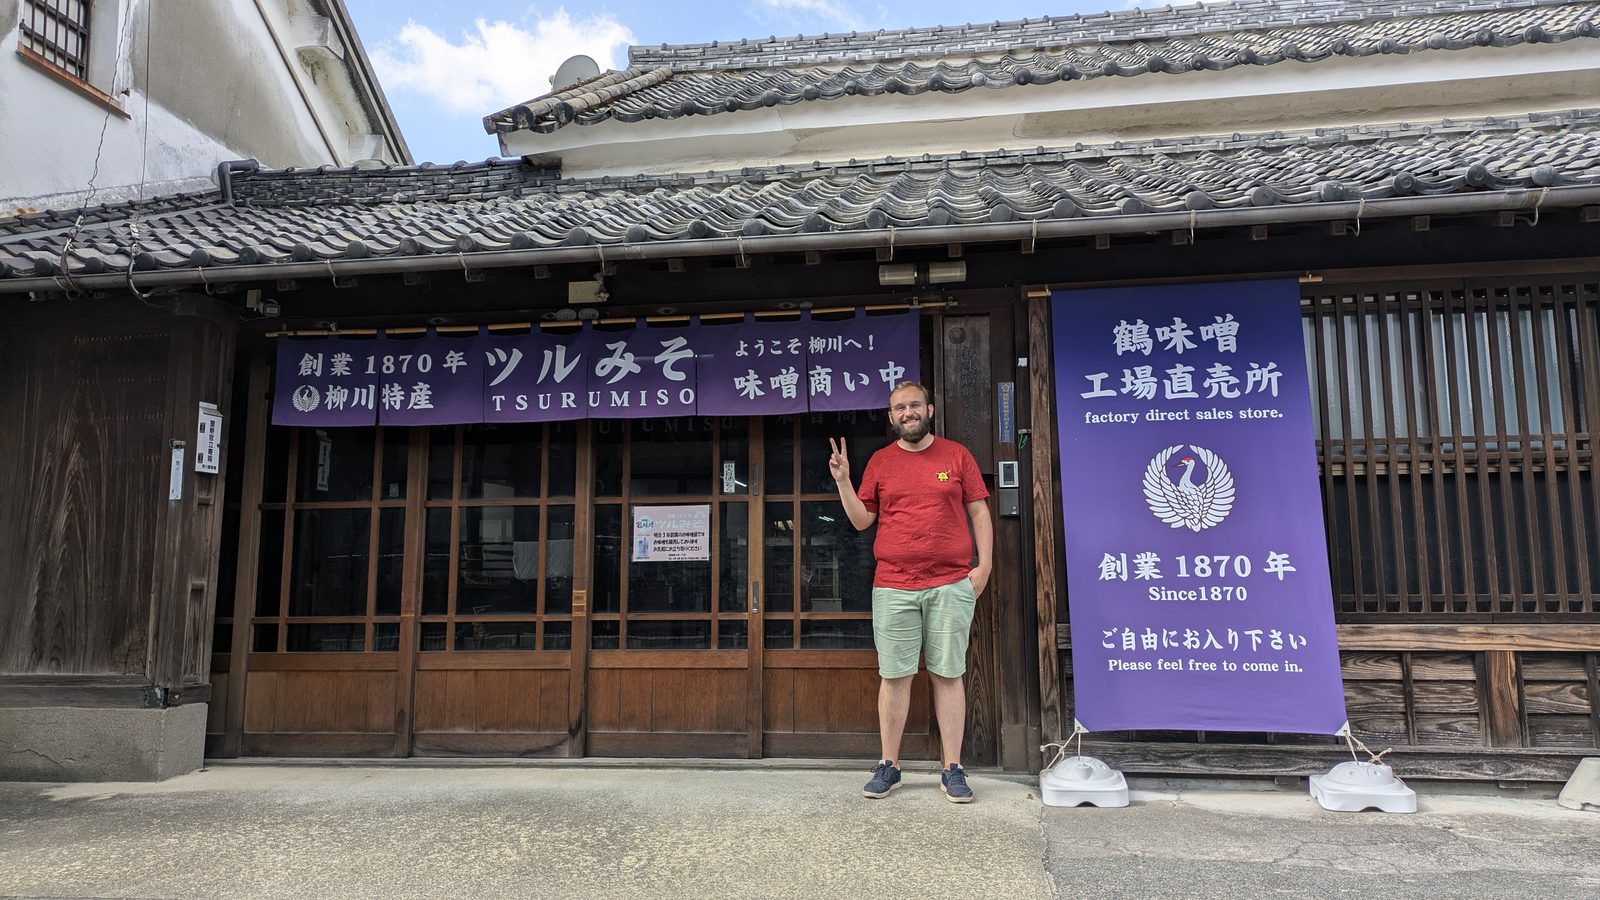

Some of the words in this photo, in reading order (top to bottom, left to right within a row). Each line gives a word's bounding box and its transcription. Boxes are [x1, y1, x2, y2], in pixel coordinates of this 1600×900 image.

[1112, 313, 1240, 356] 鶴味噌
[485, 336, 694, 387] ツルみそ
[733, 361, 906, 400] 味噌商い中
[1080, 361, 1283, 400] 工場直売所
[323, 381, 434, 411] 柳川特産
[491, 388, 695, 412] TSURUMISO
[1084, 411, 1139, 424] factory
[1145, 408, 1190, 421] direct
[1195, 407, 1234, 420] sales
[1239, 406, 1284, 419] store.
[1148, 586, 1248, 601] Since1870
[1101, 627, 1307, 652] ご自由にお入り下さい
[1108, 659, 1152, 671] Please
[1157, 658, 1183, 671] feel
[1188, 658, 1217, 671] free
[1222, 660, 1238, 672] to
[1242, 662, 1279, 672] come
[1284, 660, 1304, 673] in.
